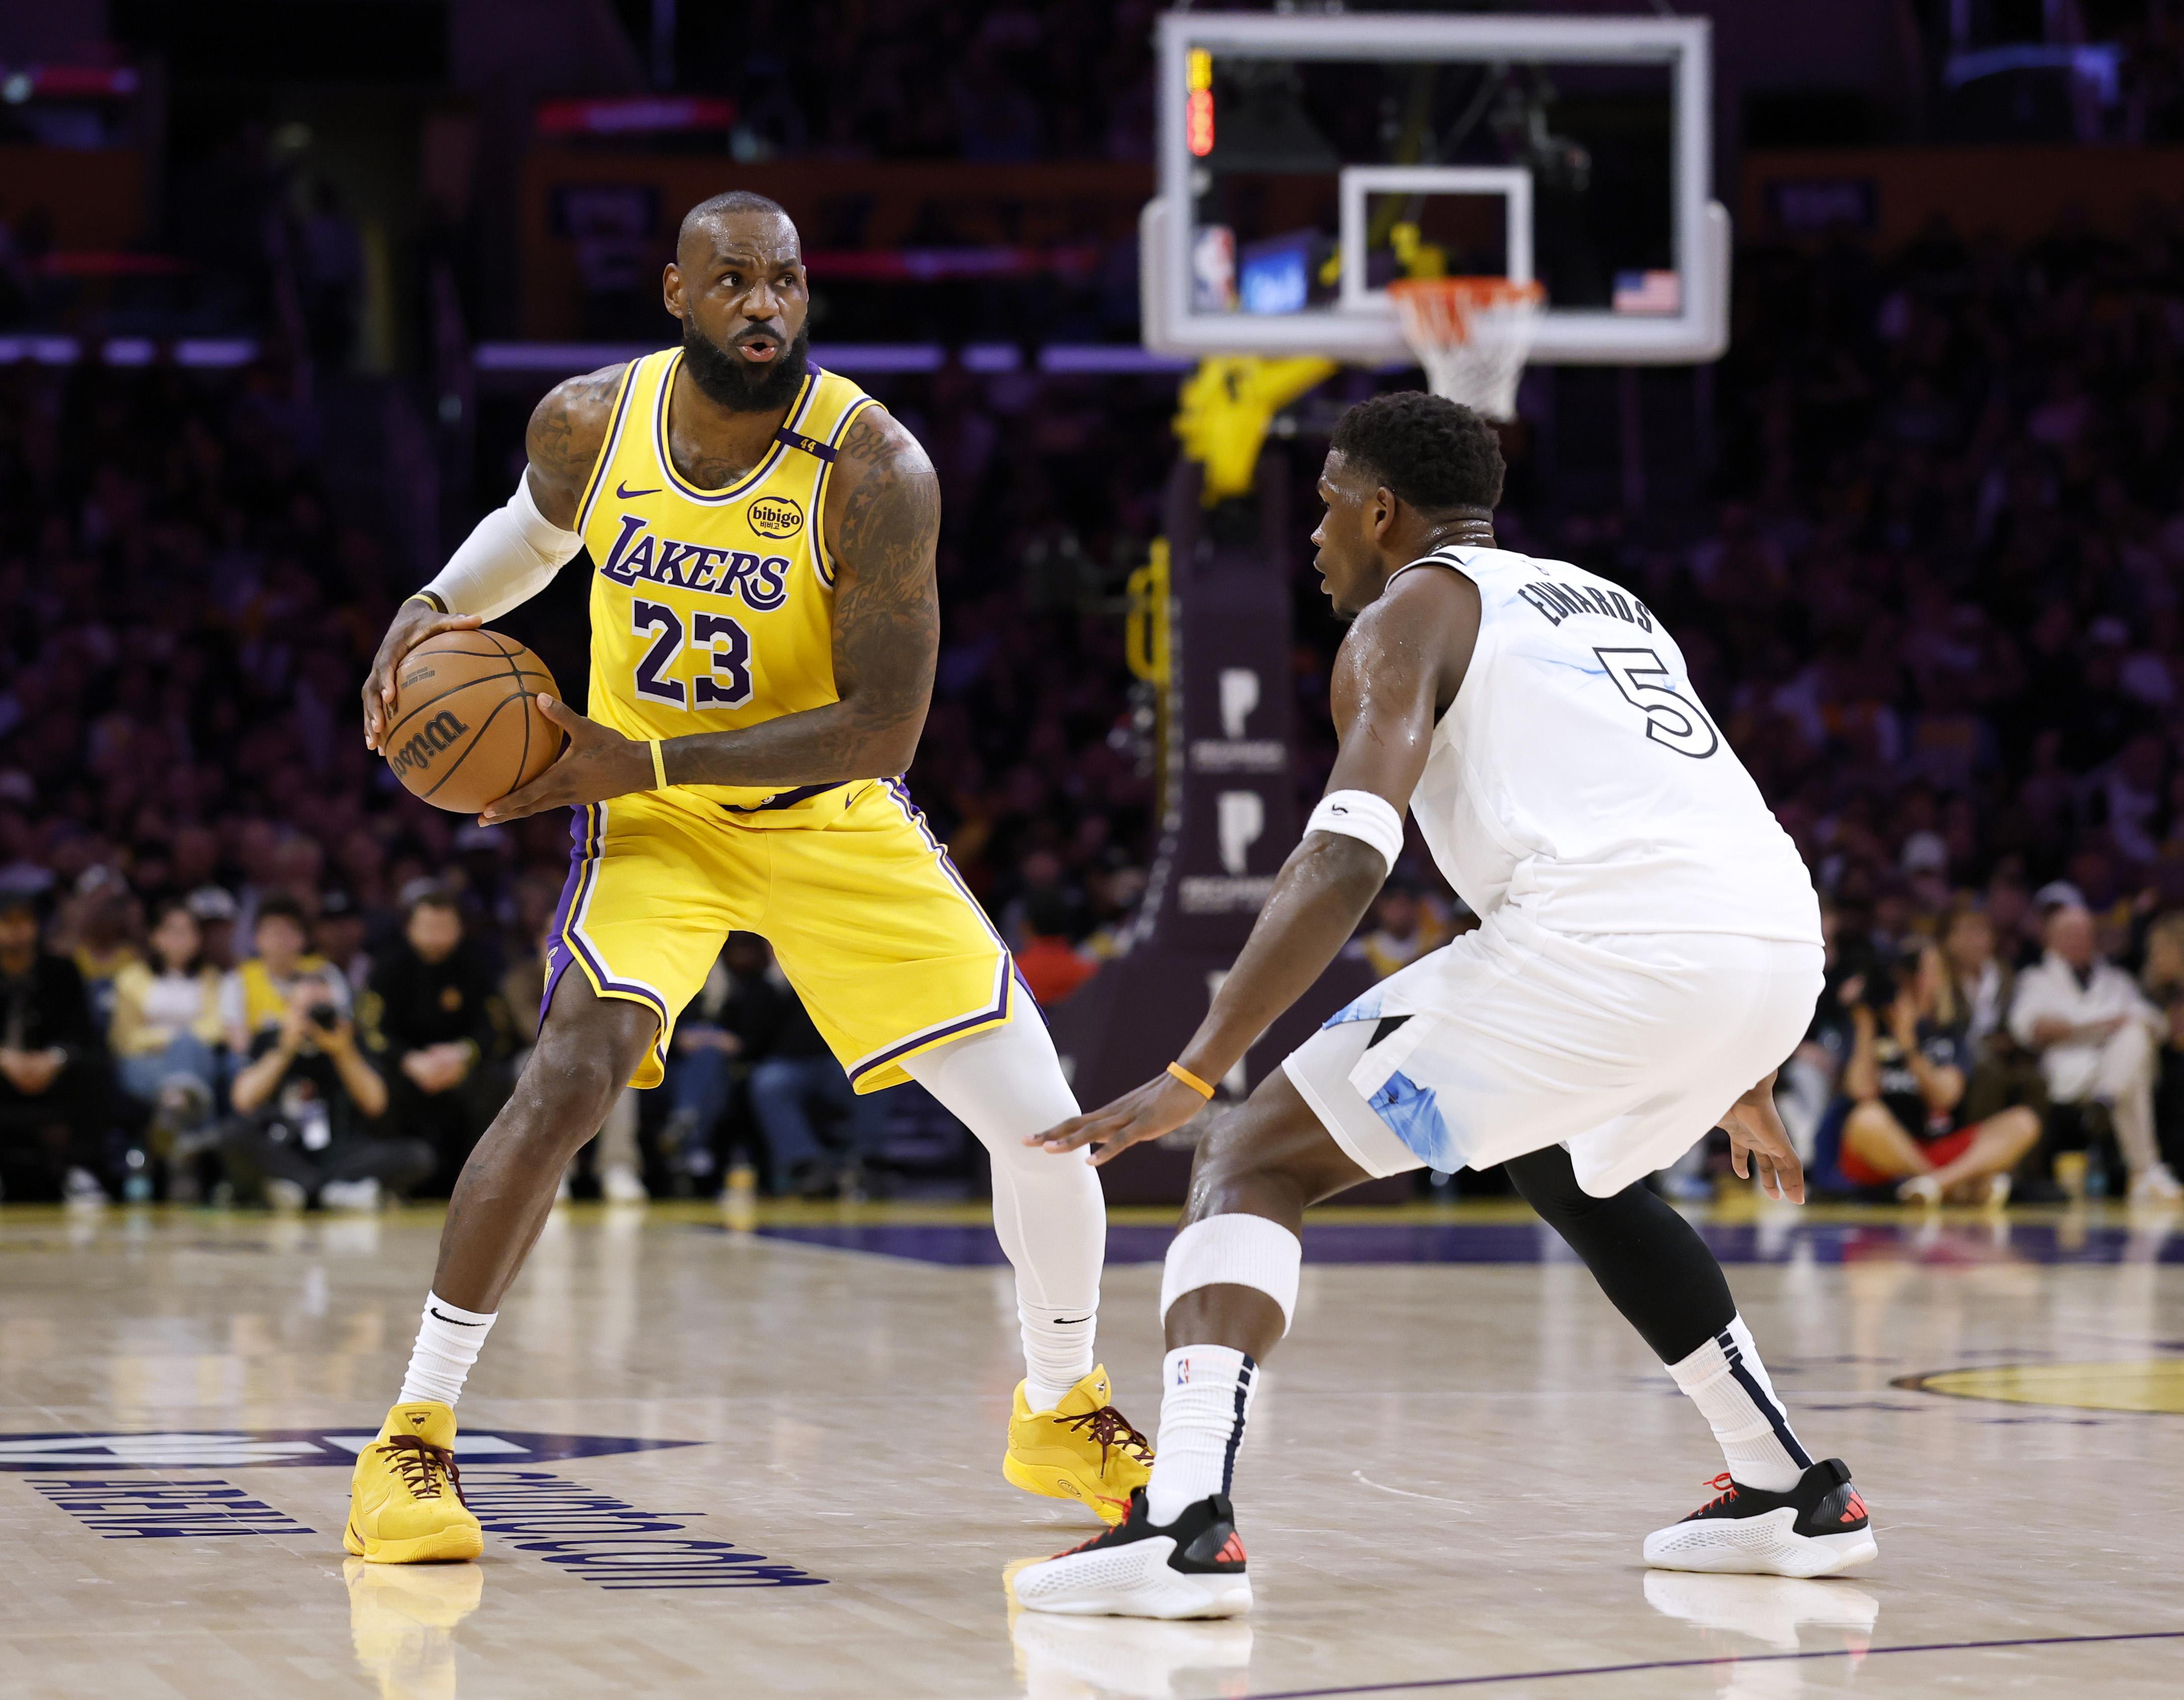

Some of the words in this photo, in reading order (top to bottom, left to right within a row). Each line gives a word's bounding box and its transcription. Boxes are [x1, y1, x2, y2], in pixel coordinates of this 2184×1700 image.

[800, 438, 816, 452] 44
[753, 506, 800, 528] bibigo
[760, 521, 780, 530] 비비고
[600, 513, 793, 612] LAKERS
[1518, 582, 1652, 633] EDWARDS
[631, 596, 753, 712] 23
[1592, 647, 1718, 759] 5
[23, 1478, 318, 1539] ARENA
